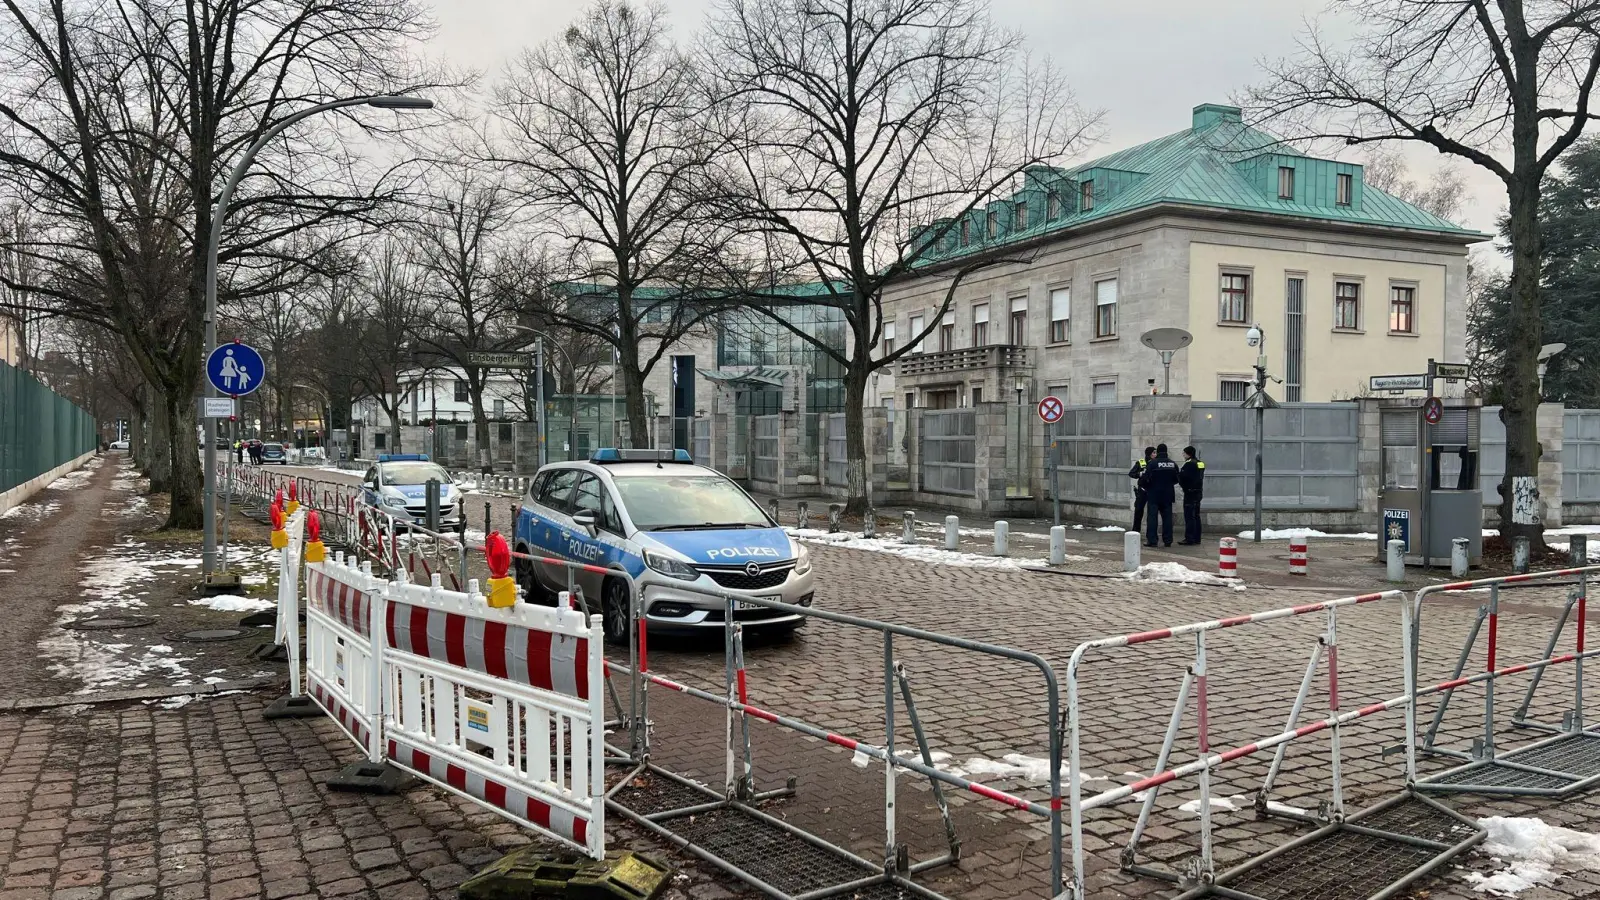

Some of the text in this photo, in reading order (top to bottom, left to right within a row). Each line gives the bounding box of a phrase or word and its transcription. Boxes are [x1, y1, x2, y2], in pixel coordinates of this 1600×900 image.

[1384, 510, 1408, 519] POLIZEI
[569, 539, 598, 562] POLIZEI
[707, 547, 779, 560] POLIZEI
